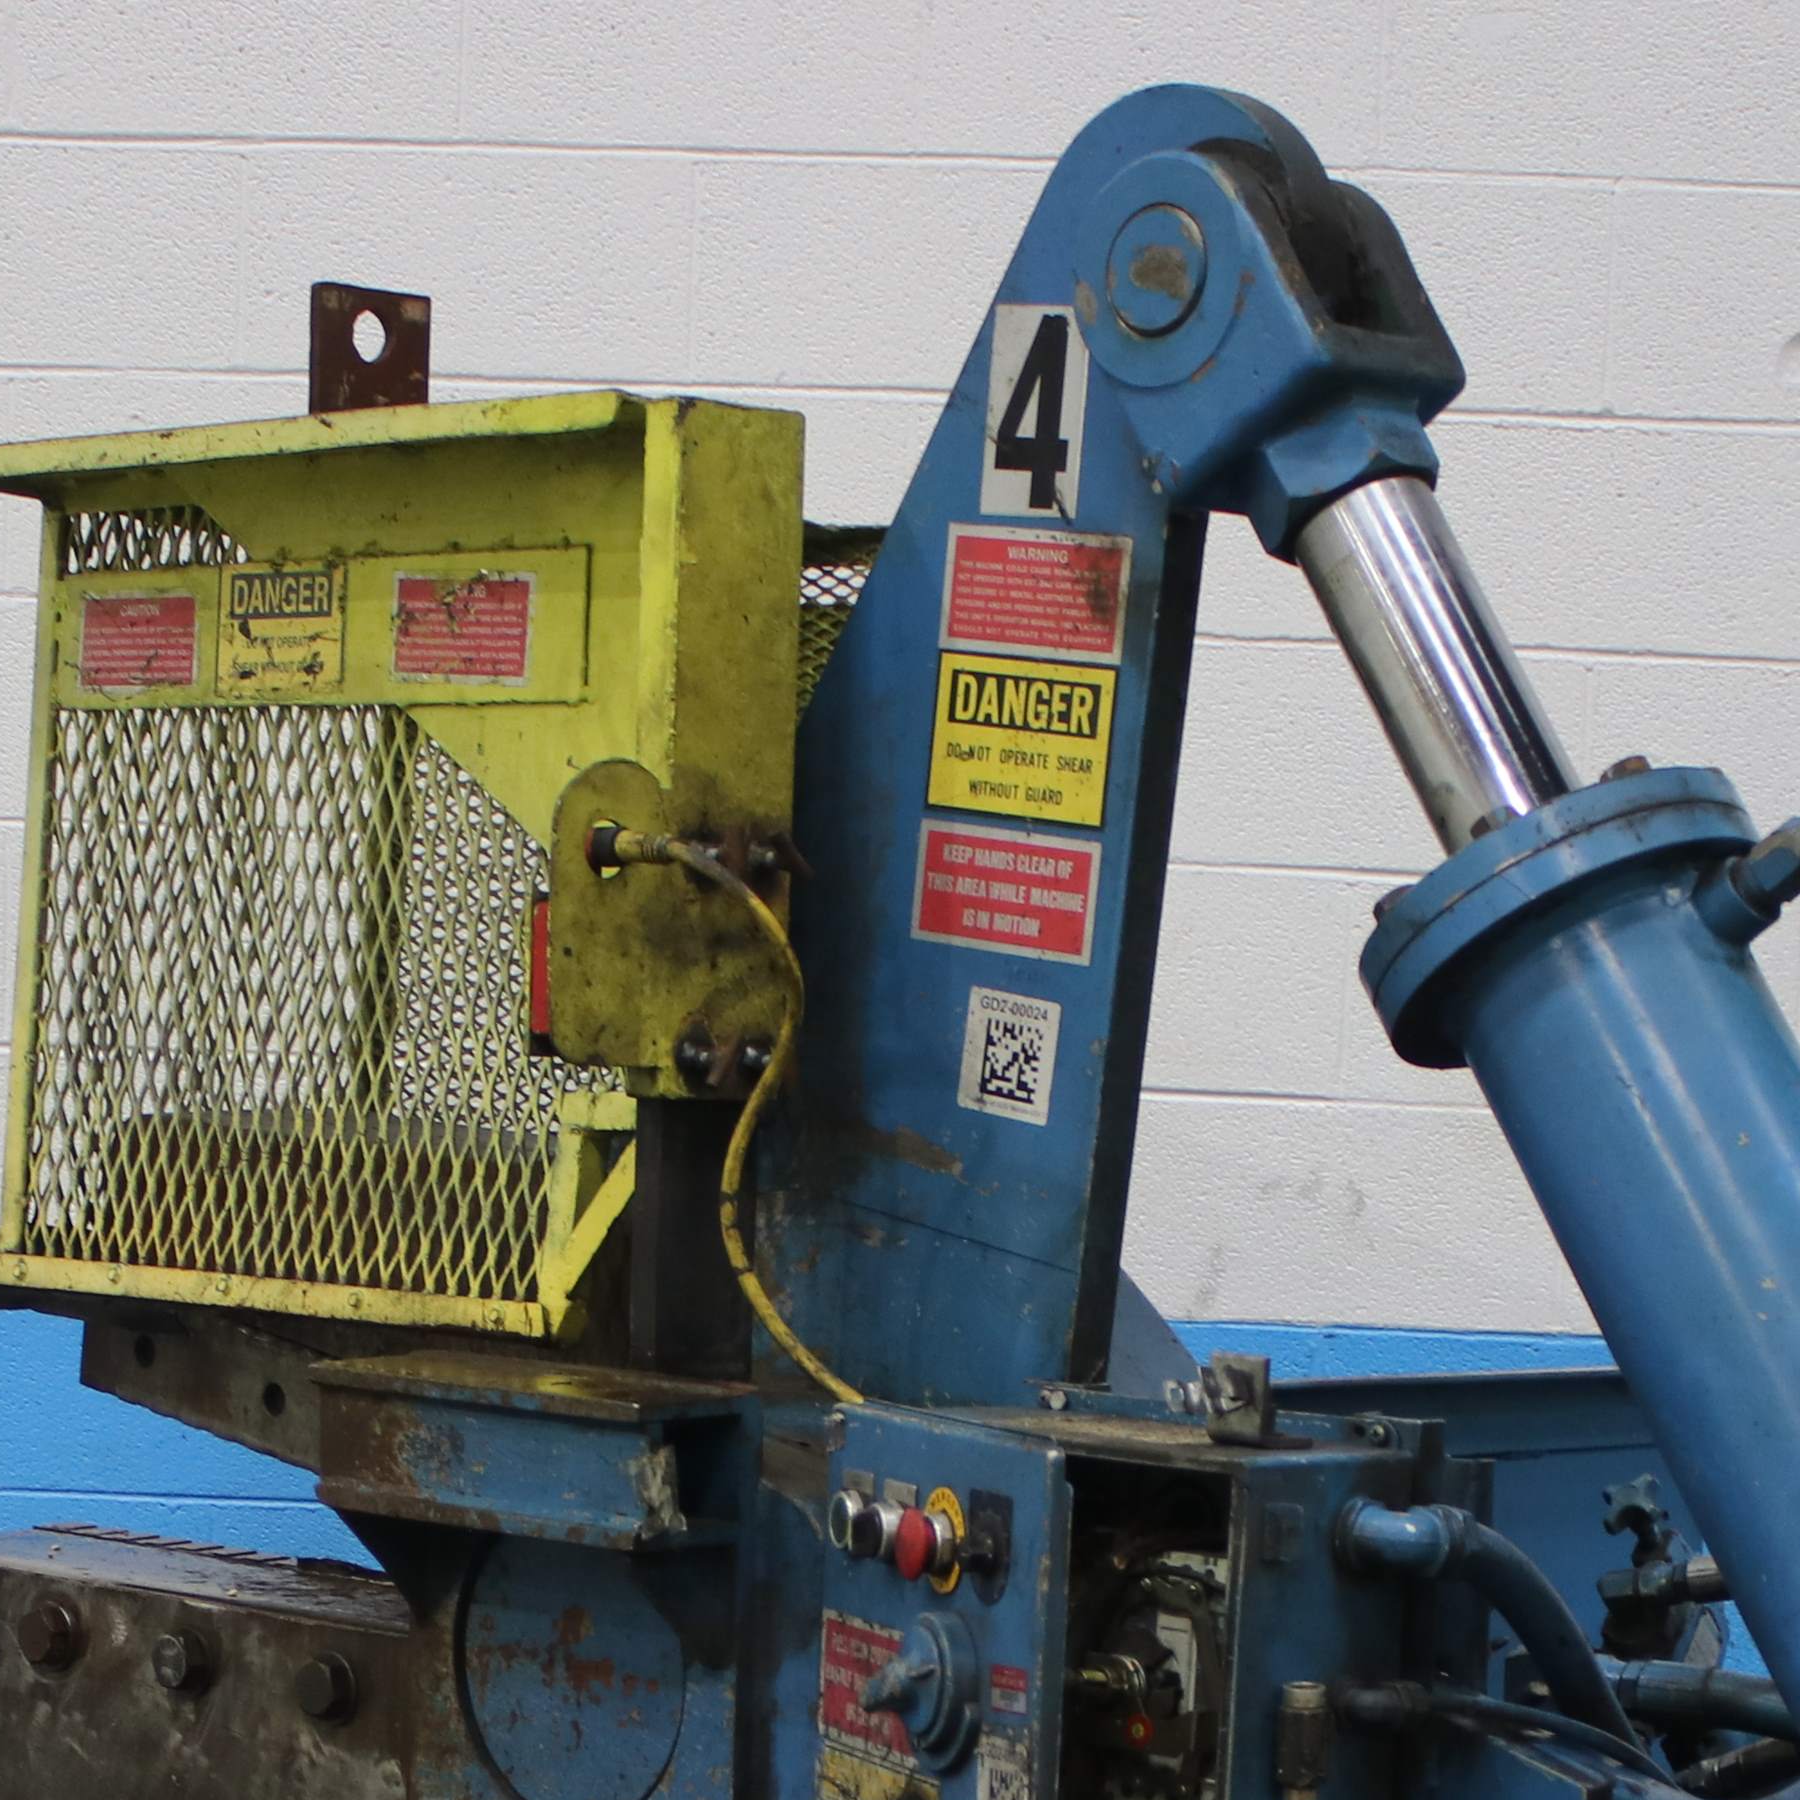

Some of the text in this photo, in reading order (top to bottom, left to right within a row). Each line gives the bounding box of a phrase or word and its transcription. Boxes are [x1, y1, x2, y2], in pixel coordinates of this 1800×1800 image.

[994, 315, 1068, 510] 4
[1007, 546, 1069, 563] WARNING
[119, 603, 161, 618] CAUTION
[233, 575, 330, 615] DANGER
[954, 672, 1094, 735] DANGER
[946, 742, 1094, 774] DO NOT OPERATE SHEAR
[968, 780, 1064, 806] WITHOUT GUARD
[943, 844, 1075, 881] KEEP HANDS CLEAR OF
[927, 872, 1086, 913] THIS AREA WHILE MACHINE
[962, 908, 1041, 938] IS IN MOTION
